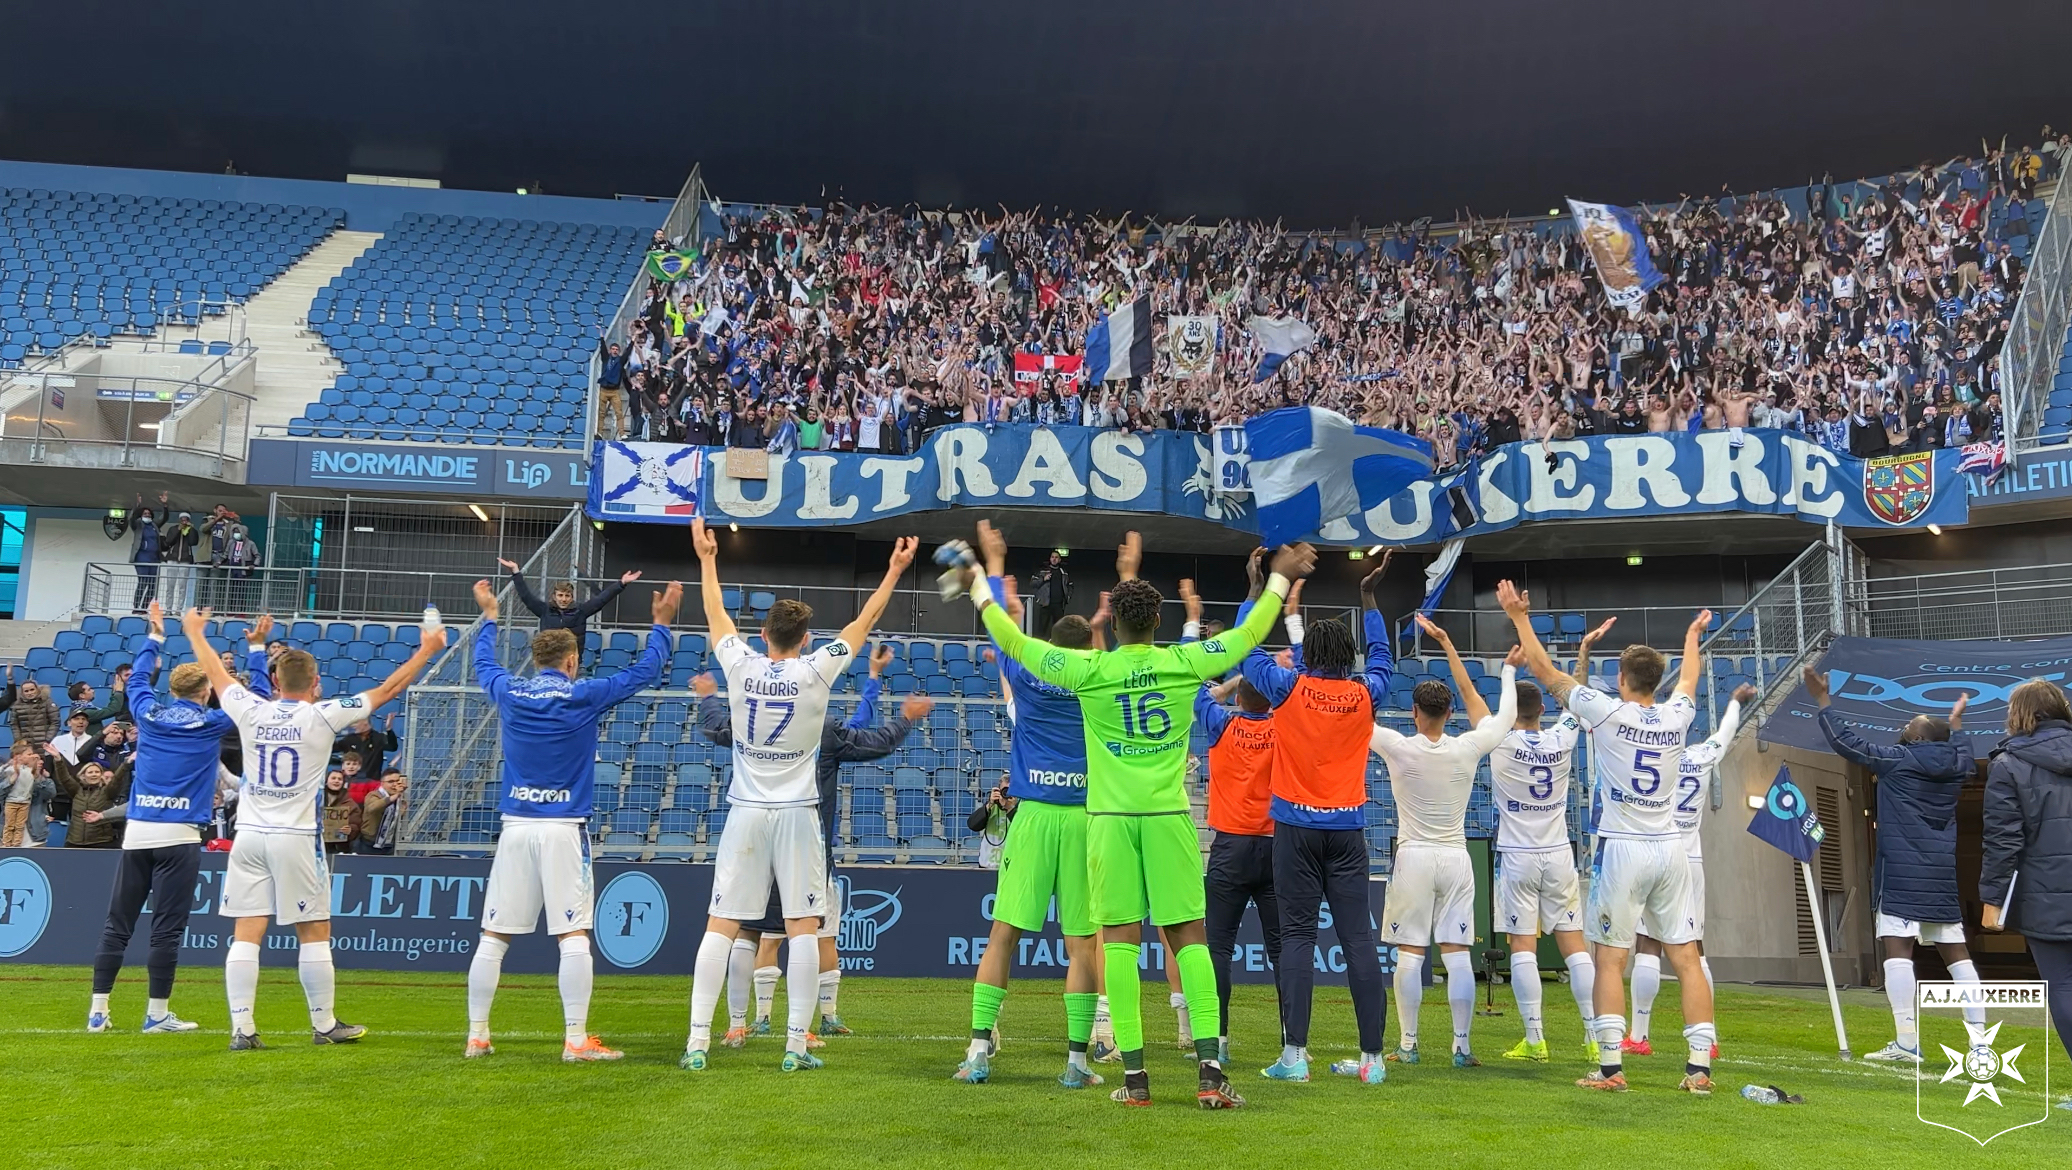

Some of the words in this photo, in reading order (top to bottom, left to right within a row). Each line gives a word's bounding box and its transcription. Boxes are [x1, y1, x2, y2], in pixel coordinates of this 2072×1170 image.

[1188, 321, 1202, 331] 30
[1221, 428, 1250, 455] U
[311, 450, 320, 471] PARIS
[320, 450, 478, 479] NORMANDIE
[1872, 454, 1927, 466] BOURGOGNE
[708, 427, 1148, 519] ULTRAS
[1319, 431, 1845, 541] UXERRE
[1919, 662, 2012, 673] Centre
[1301, 686, 1364, 703] macron
[744, 697, 796, 746] 17
[1115, 692, 1172, 741] 16
[256, 725, 302, 741] PERRIN
[1616, 724, 1681, 747] PELLENARD
[745, 748, 805, 762] Groupama
[1123, 739, 1184, 755] Groupama
[1514, 748, 1562, 765] BERNARD
[255, 744, 299, 788] 10
[1631, 749, 1662, 797] 5
[1029, 768, 1087, 788] macro
[1528, 766, 1554, 801] 3
[135, 794, 190, 810] macron
[181, 925, 218, 949] lus
